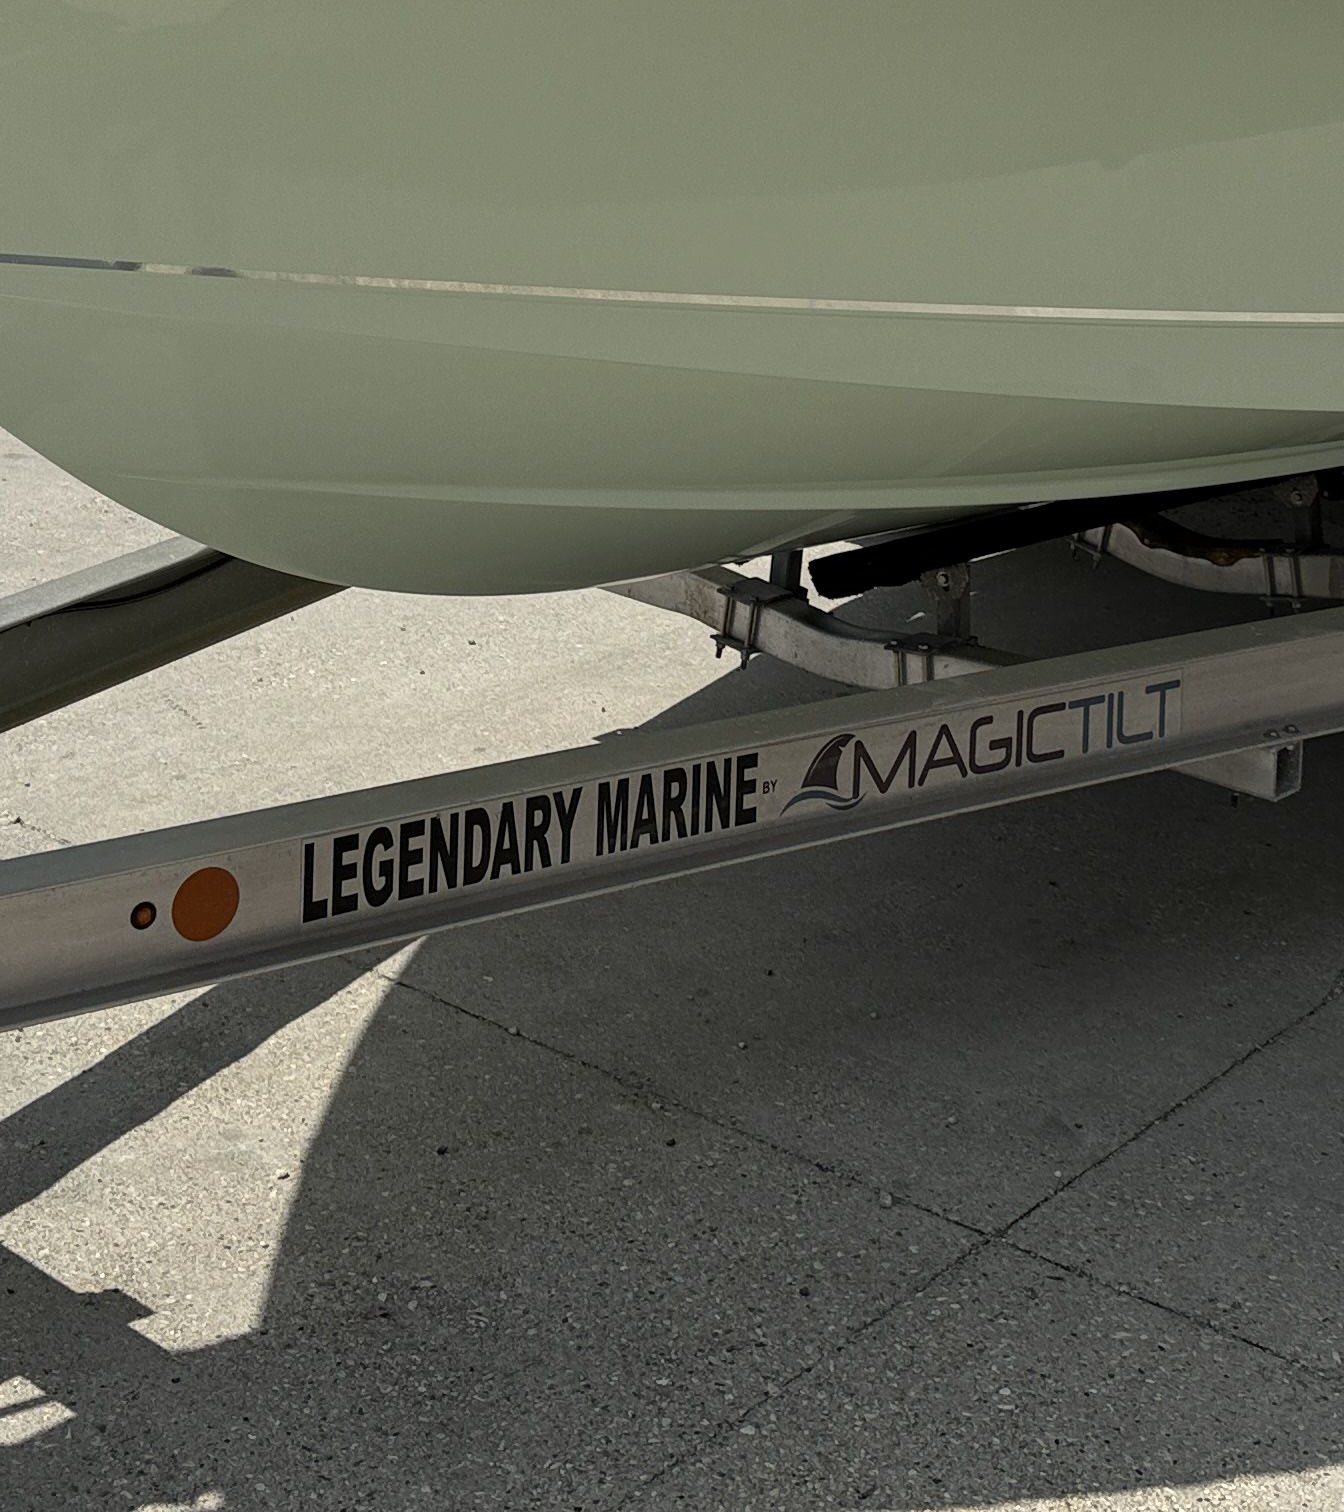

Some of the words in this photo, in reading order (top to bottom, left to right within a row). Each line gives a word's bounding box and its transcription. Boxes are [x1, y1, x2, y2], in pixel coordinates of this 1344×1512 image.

[301, 786, 584, 924] LEGENDARY
[595, 752, 759, 857] MARINE
[761, 779, 779, 795] BY
[852, 679, 1182, 799] MAGICTILT
